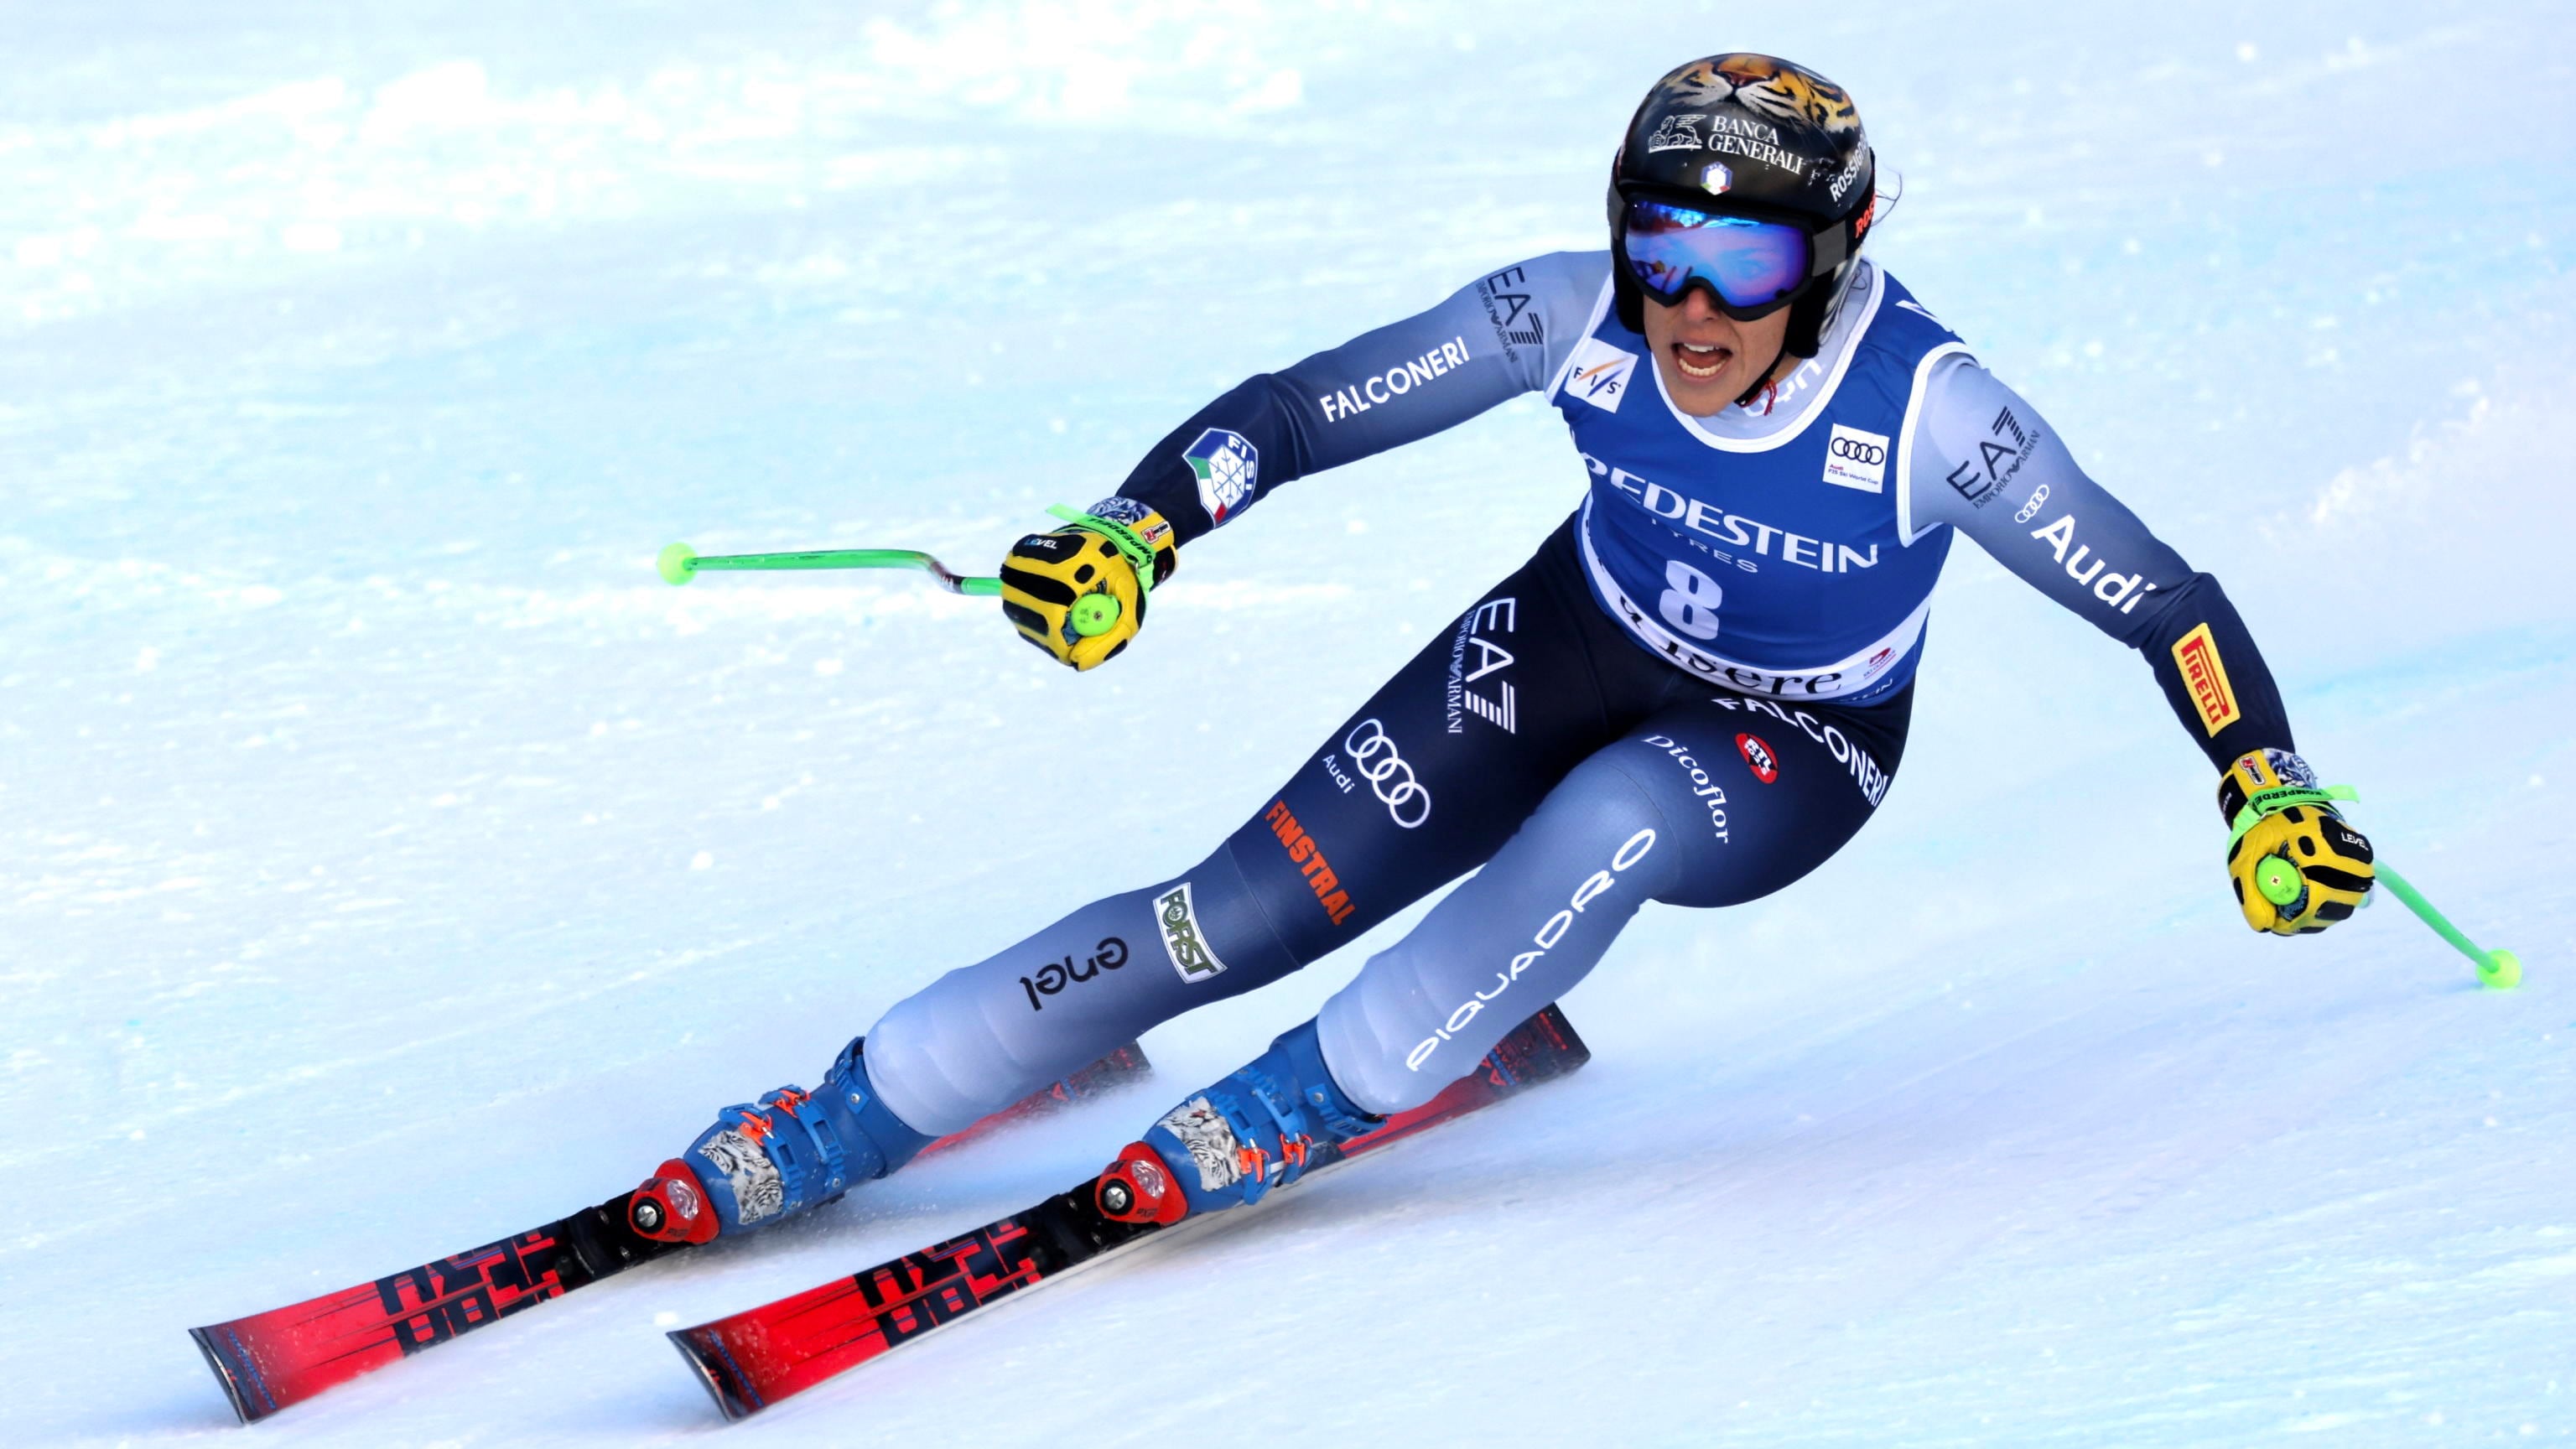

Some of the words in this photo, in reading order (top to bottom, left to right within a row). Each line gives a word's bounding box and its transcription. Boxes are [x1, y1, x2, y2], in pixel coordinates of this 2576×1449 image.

[1707, 134, 1805, 175] GENERALI
[1711, 115, 1779, 145] BANCA
[1487, 266, 1545, 345] EA7
[1319, 336, 1470, 423] FALCONERI
[1945, 406, 2026, 501] EA7
[1659, 559, 1723, 641] 8
[2030, 514, 2157, 615] Audi
[1446, 675, 1462, 734] ARMANI
[1465, 598, 1516, 735] EA7
[2180, 635, 2231, 724] PIRELLI
[1322, 754, 1354, 794] Audi
[1641, 735, 1728, 844] Dicoflor
[1711, 698, 1888, 807] FALCONERI
[1265, 800, 1355, 926] FINSTRAL
[1019, 937, 1129, 1011] enel
[1161, 888, 1218, 974] FORST
[1405, 828, 1656, 1072] PIQUADRO
